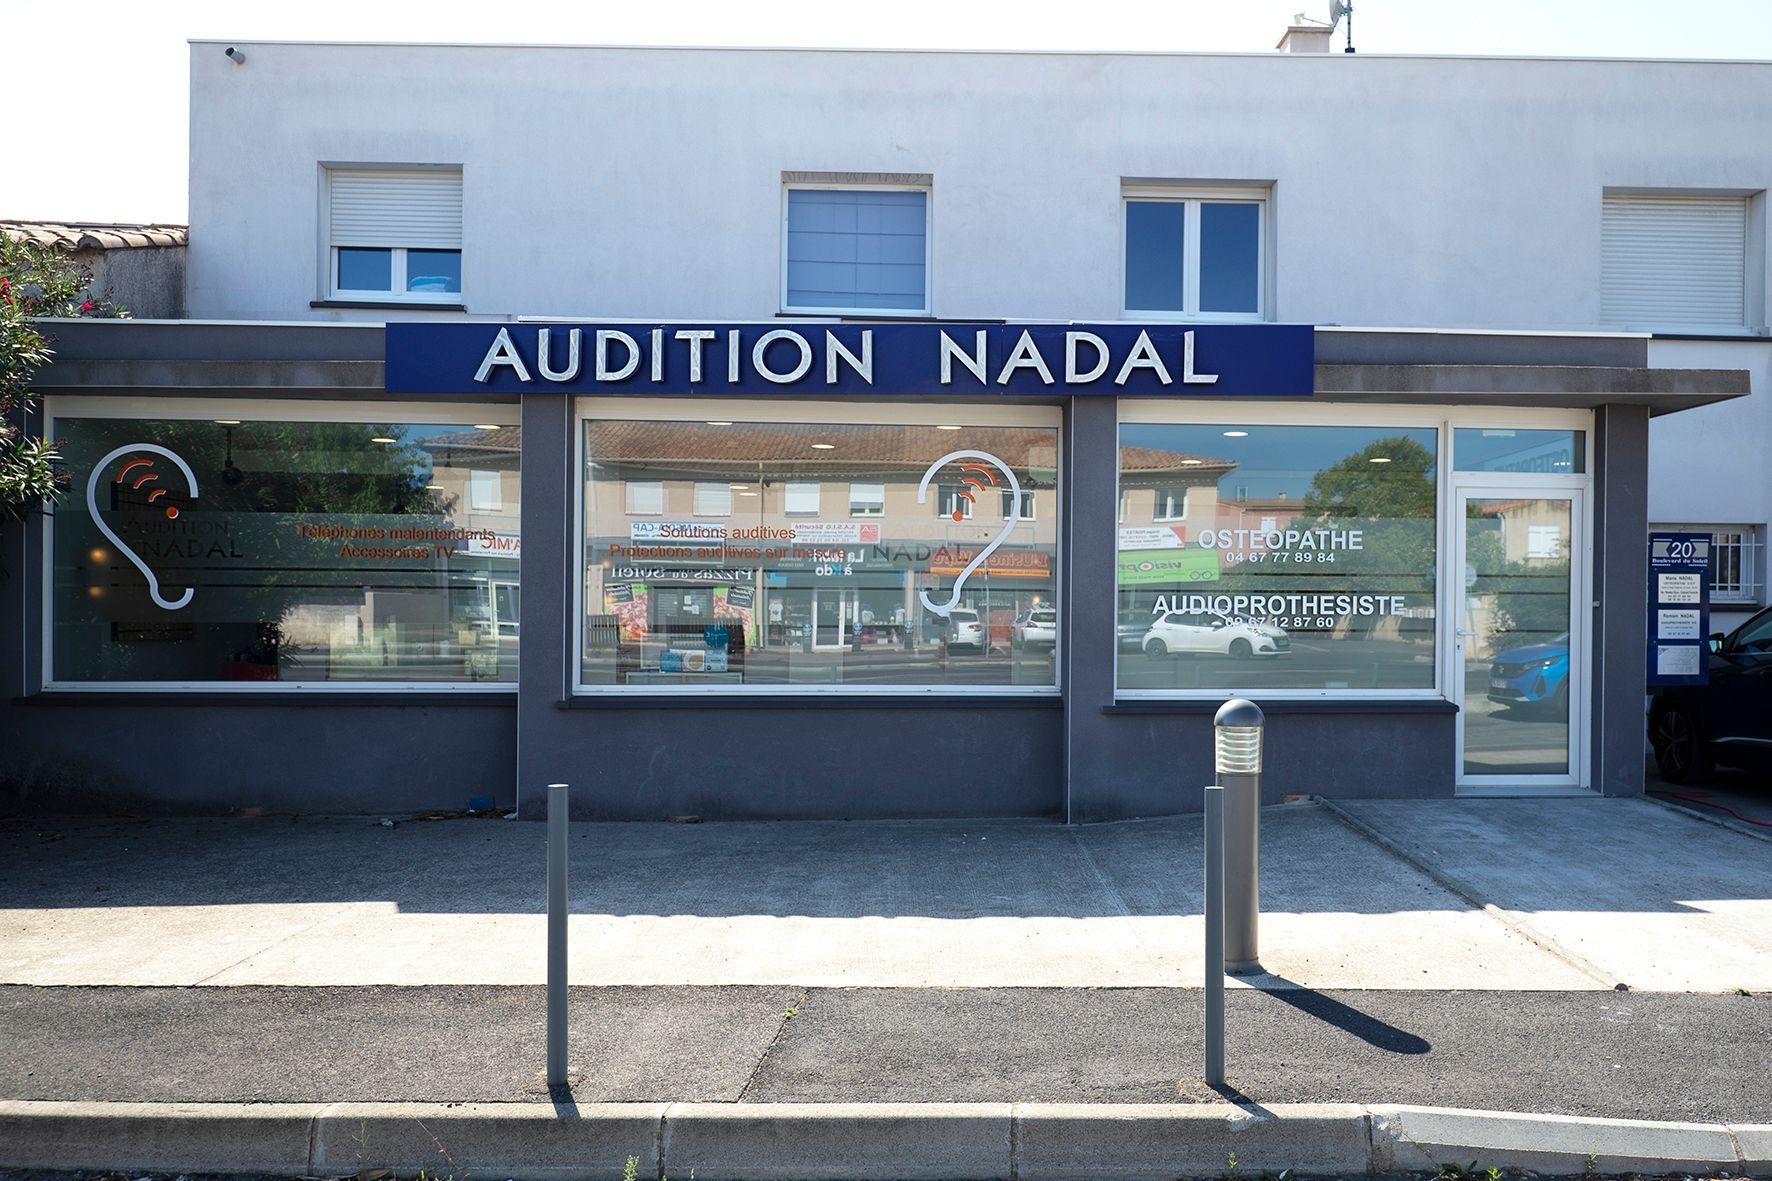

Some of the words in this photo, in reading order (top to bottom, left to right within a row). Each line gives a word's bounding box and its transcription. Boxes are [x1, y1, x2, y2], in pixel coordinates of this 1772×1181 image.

[473, 326, 874, 384] AUDITION
[939, 328, 1220, 386] NADAL
[388, 527, 495, 541] malentendants
[660, 524, 728, 539] Solutions
[732, 525, 796, 539] auditives
[1198, 529, 1364, 550] OSTEOPATHE
[142, 539, 243, 558] NADAL
[339, 544, 429, 559] Accessoires
[433, 546, 455, 559] TV
[609, 543, 693, 559] Protections
[697, 544, 761, 559] auditives
[765, 547, 787, 559] sur
[873, 544, 969, 562] NADAL
[1671, 542, 1692, 557] 20
[1226, 552, 1244, 563] 04
[1249, 552, 1267, 563] 67
[1271, 552, 1289, 563] 77
[1294, 552, 1312, 563] 89
[1317, 552, 1335, 563] 84
[1151, 595, 1406, 616] AUDIOPROTHESISTE
[1225, 617, 1243, 628] 09
[1247, 617, 1266, 628] 67
[1272, 617, 1289, 628] 12
[1294, 617, 1312, 628] 87
[1317, 617, 1335, 628] 60
